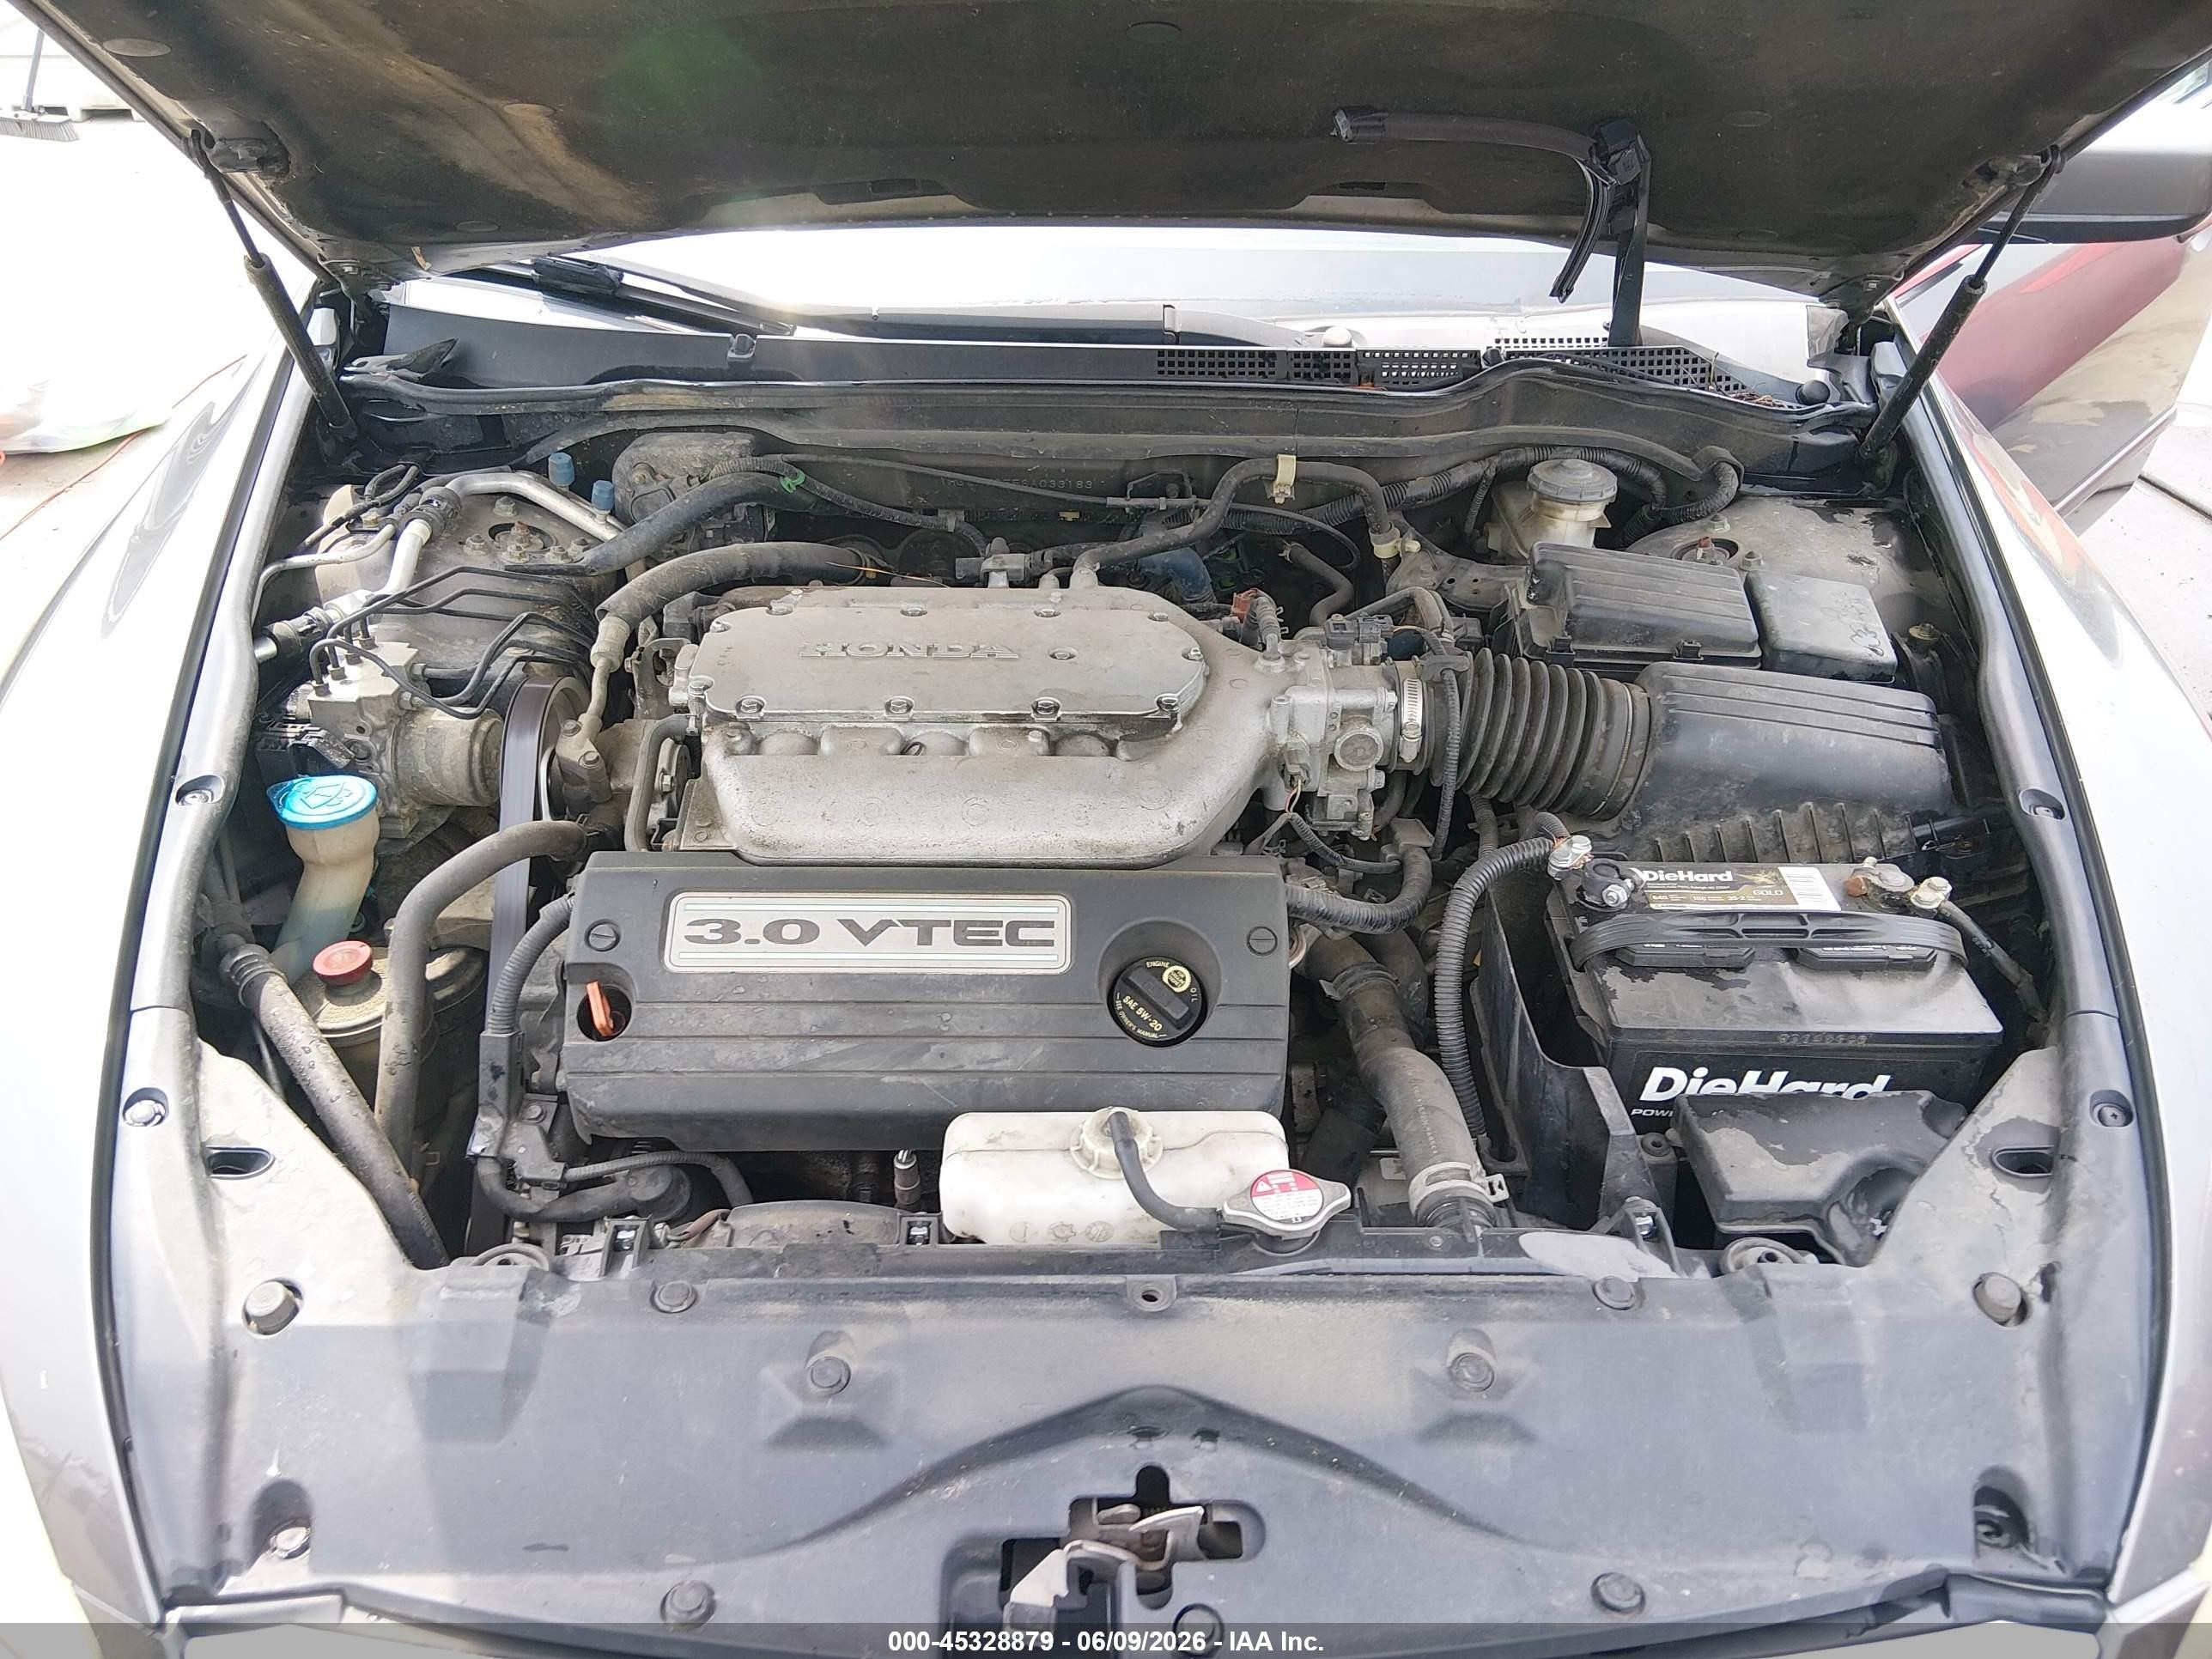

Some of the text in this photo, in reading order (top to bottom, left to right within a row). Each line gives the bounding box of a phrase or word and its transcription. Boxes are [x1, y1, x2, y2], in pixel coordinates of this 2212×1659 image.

[799, 642, 1018, 659] HONDA
[1641, 870, 1734, 883] DieHard
[684, 919, 1054, 946] 3.0 VTEC
[1123, 996, 1139, 1010] SAE
[1631, 1109, 1674, 1117] POW
